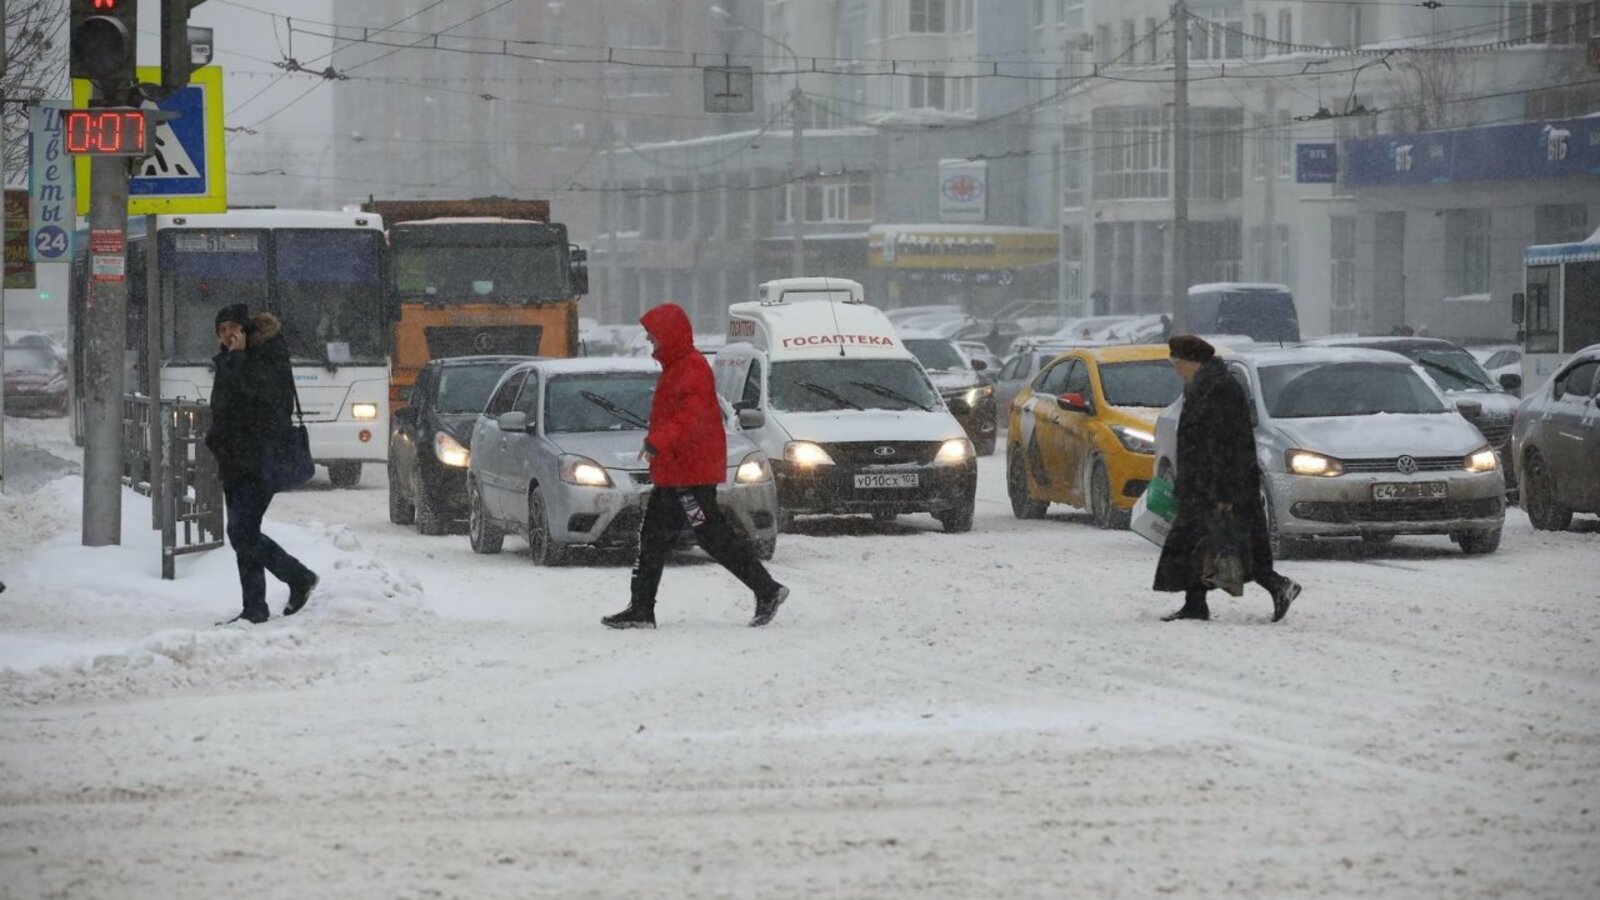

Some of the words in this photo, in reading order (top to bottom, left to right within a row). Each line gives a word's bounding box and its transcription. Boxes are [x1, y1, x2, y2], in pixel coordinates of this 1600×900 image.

[68, 111, 145, 152] 0:07
[37, 232, 66, 251] 24
[783, 334, 894, 348] ГОСАПТЕКА
